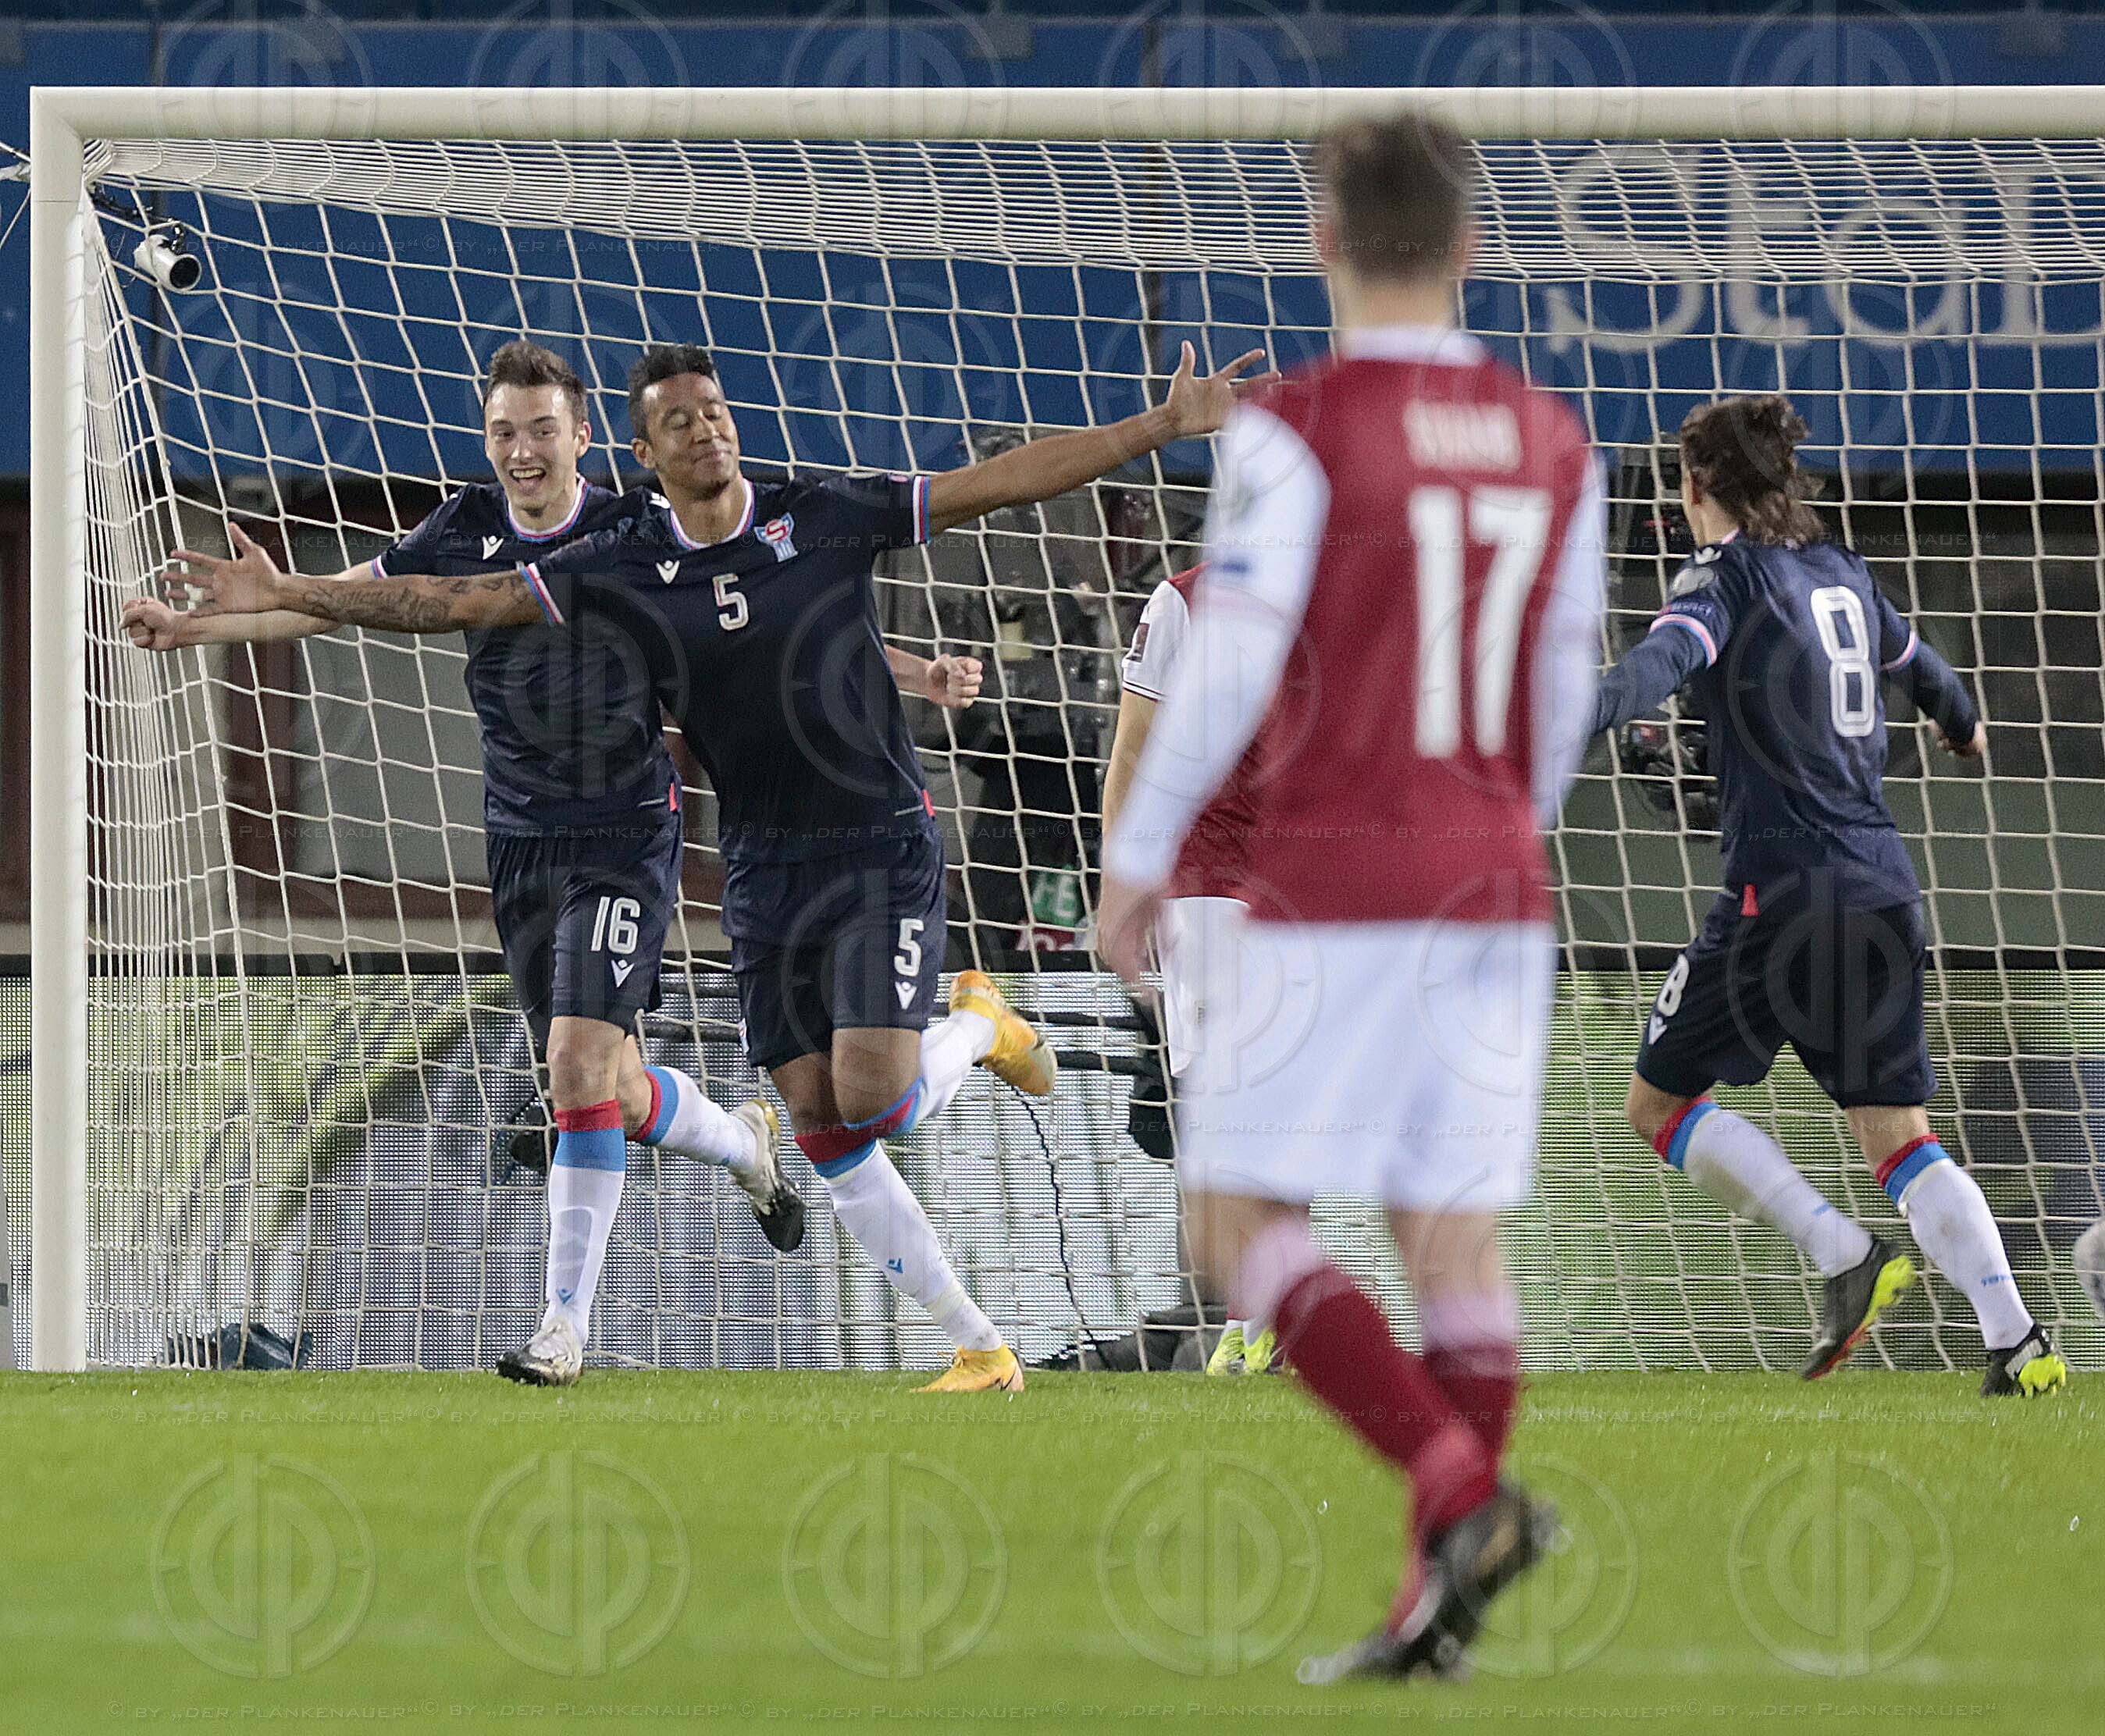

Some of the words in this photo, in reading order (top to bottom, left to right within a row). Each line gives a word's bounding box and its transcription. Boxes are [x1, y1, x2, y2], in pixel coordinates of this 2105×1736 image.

[711, 572, 750, 631] 5
[1407, 484, 1554, 760] 17
[1809, 585, 1877, 739] 8
[590, 895, 642, 955] 16
[893, 917, 925, 978] 5
[1654, 953, 1691, 1019] 8
